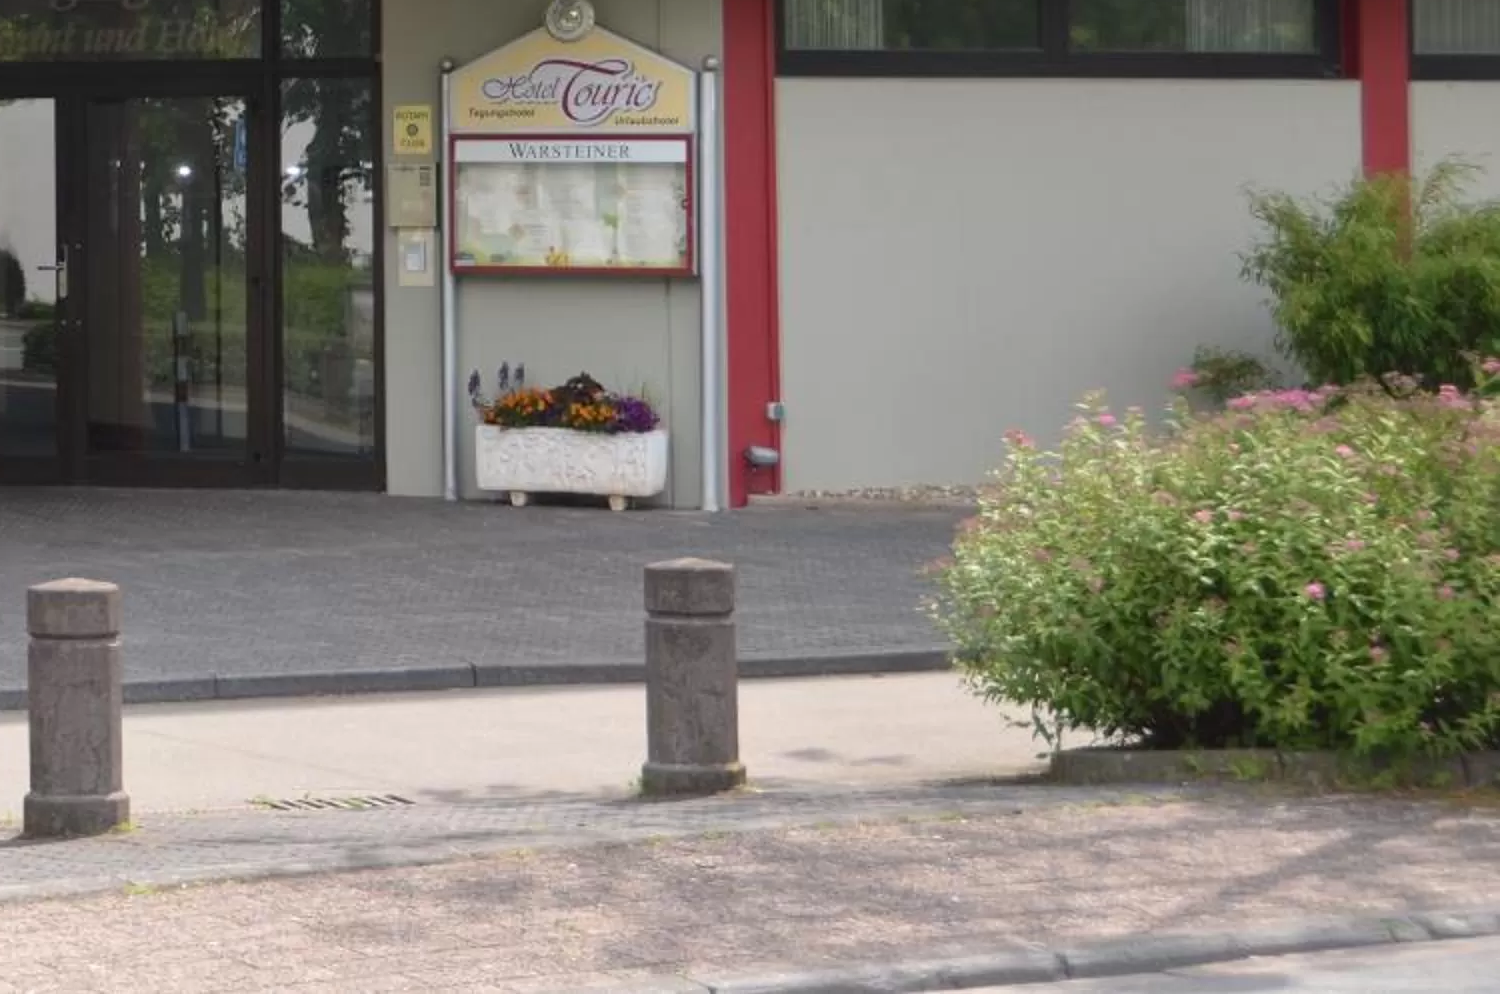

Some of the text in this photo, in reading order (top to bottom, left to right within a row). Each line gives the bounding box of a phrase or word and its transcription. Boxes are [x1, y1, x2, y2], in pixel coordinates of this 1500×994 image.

[482, 59, 653, 122] Hotel Touric
[509, 142, 631, 159] WARSTEINER
